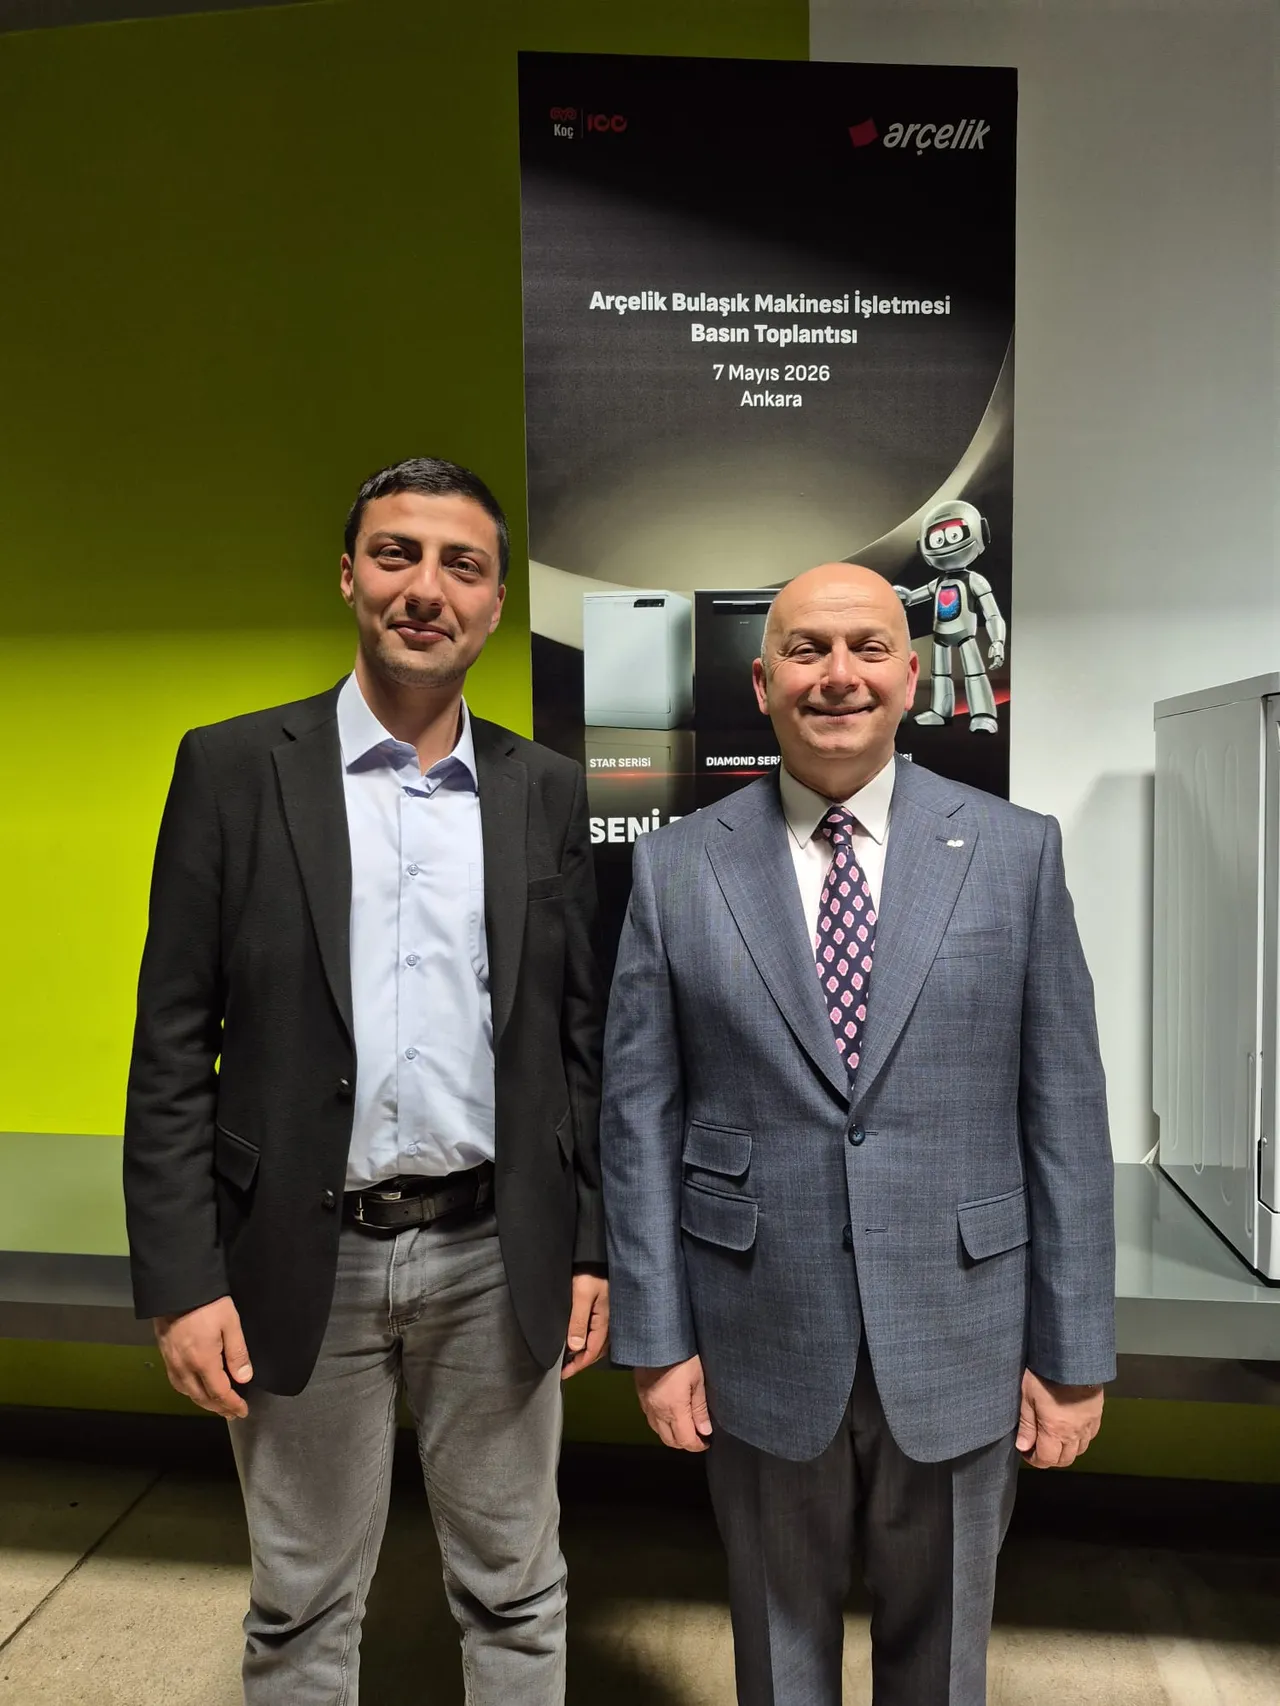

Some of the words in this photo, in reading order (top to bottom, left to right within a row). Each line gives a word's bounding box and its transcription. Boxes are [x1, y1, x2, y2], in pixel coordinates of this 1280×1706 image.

[554, 123, 574, 139] Koç
[883, 119, 991, 156] arçelik
[589, 291, 667, 315] Arçelik
[672, 292, 750, 317] Bulaşık
[754, 293, 849, 313] Makinesi
[854, 289, 951, 318] İşletmesi
[691, 323, 750, 342] Basın
[753, 324, 858, 347] Toplantısı
[712, 364, 725, 380] 7
[728, 364, 780, 384] Mayıs
[784, 365, 830, 381] 2026
[740, 390, 803, 407] Ankara
[589, 758, 616, 768] STAR
[706, 756, 755, 767] DIAMOND
